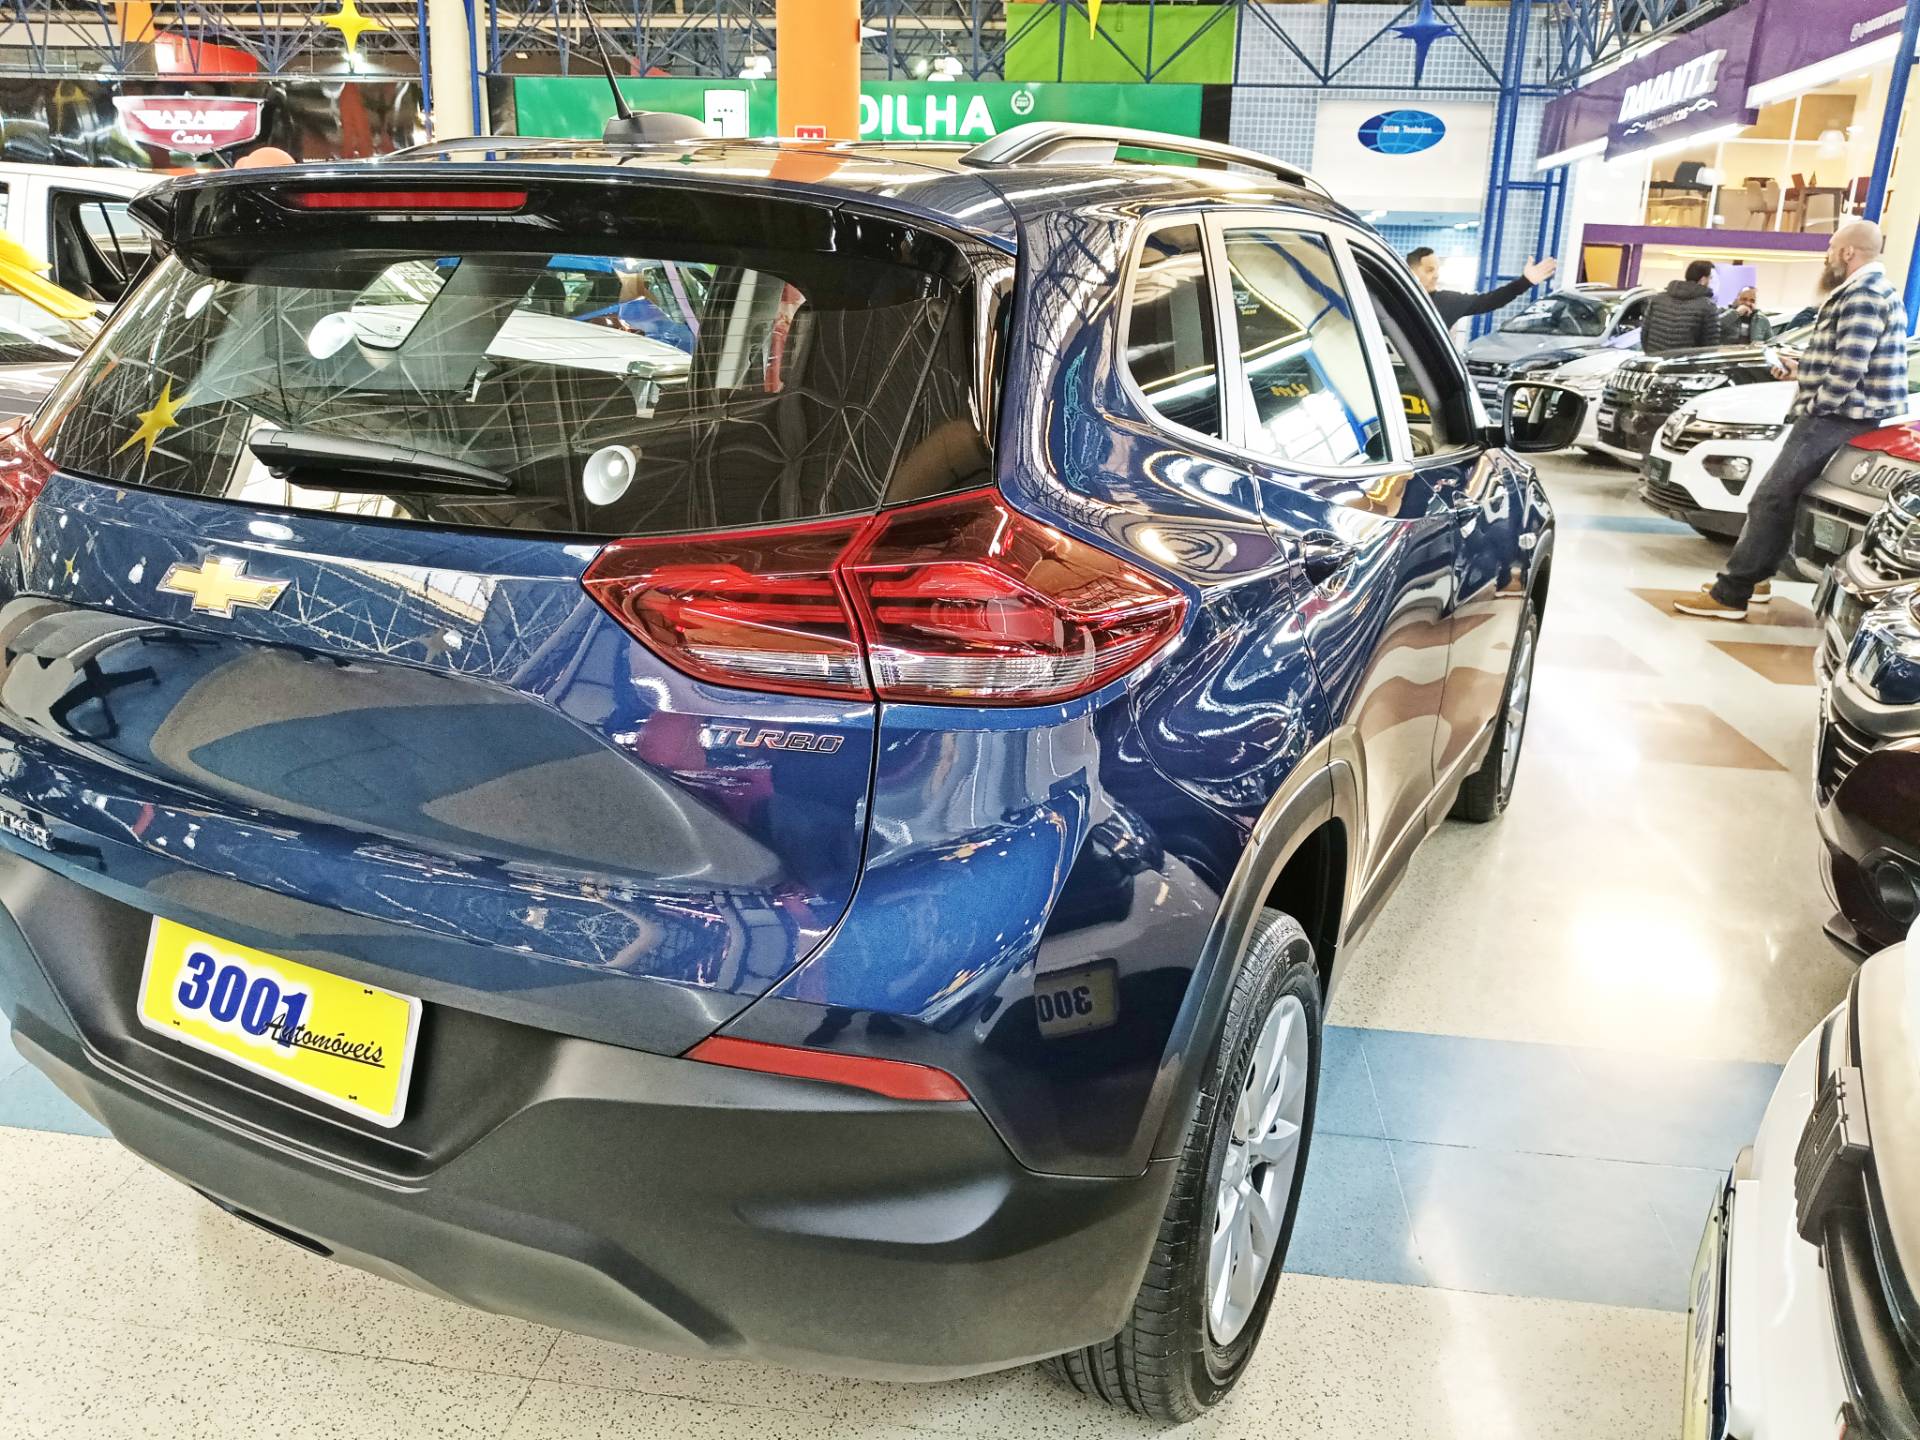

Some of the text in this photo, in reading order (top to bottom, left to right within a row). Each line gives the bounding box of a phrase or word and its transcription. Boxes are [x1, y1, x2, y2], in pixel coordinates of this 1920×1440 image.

[1617, 49, 1722, 124] DAVANTI
[171, 130, 214, 144] Cars
[708, 724, 845, 754] TURBO
[178, 952, 307, 1048] 3001
[263, 1013, 384, 1063] Automóveis
